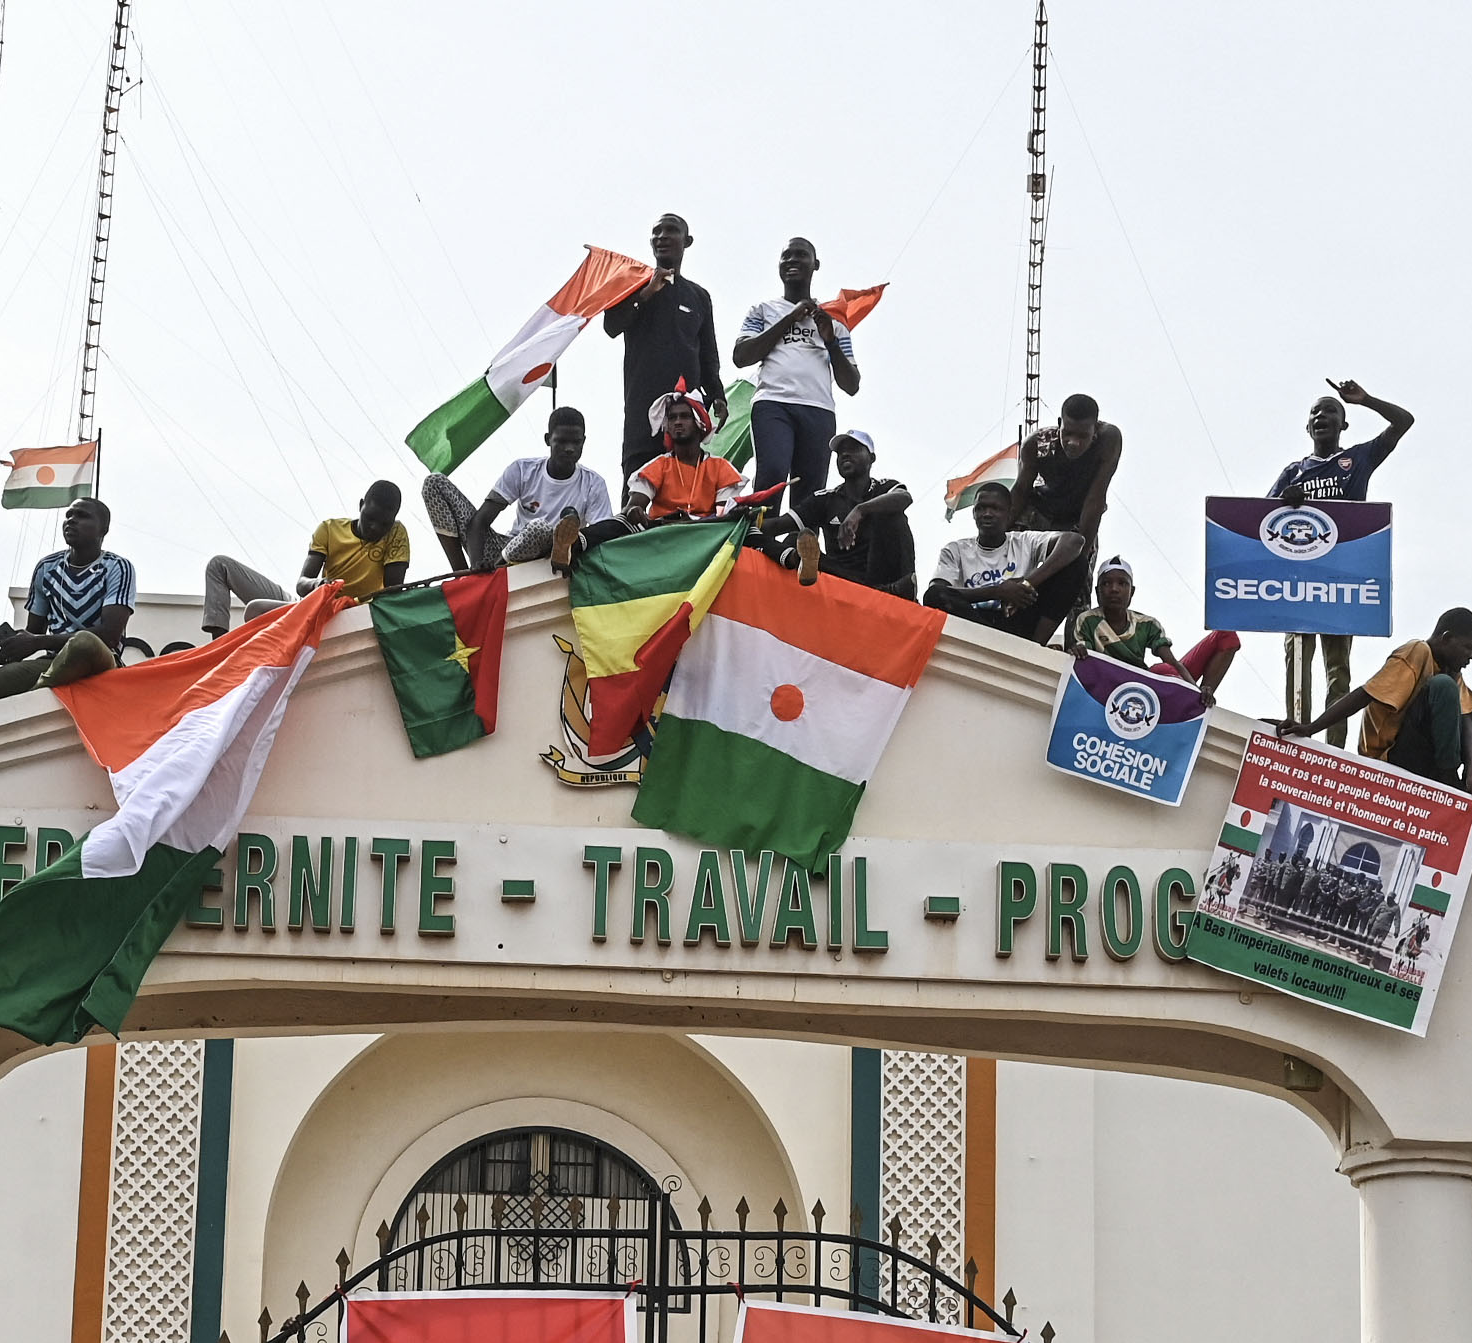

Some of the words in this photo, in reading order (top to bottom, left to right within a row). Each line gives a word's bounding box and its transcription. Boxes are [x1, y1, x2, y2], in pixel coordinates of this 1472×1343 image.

[784, 326, 816, 338] ber
[1214, 578, 1380, 605] SECURITÉ
[1072, 732, 1167, 777] COHÉSION
[1073, 751, 1155, 791] SOCIALE
[1253, 734, 1298, 758] Gamkallé
[1299, 750, 1338, 769] apporte
[1339, 763, 1357, 776] son
[1359, 769, 1395, 788] soutien
[1397, 779, 1454, 807] indéfectible
[1455, 800, 1468, 811] au
[1259, 774, 1269, 787] la
[1270, 780, 1333, 808] souveraineté
[1334, 800, 1346, 812] et
[1347, 802, 1392, 826] l'honneur
[1393, 819, 1406, 831] de
[1407, 822, 1417, 835] la
[1418, 827, 1449, 846] patrie.
[1292, 768, 1310, 781] FDS
[1312, 774, 1323, 785] et
[1324, 778, 1337, 790] au
[1337, 783, 1371, 800] peuple
[1373, 792, 1407, 812] debout
[1407, 805, 1431, 820] pour
[582, 845, 890, 953] TRAVAIL
[995, 859, 1197, 965] PROG
[1204, 918, 1226, 937] Bas
[1228, 926, 1310, 965] l'impérialisme
[1312, 957, 1383, 990] monstrueux
[1384, 982, 1397, 995] et
[1399, 987, 1421, 1002] ses
[1254, 961, 1289, 983] valets
[1291, 971, 1347, 1001] locaux!!!!
